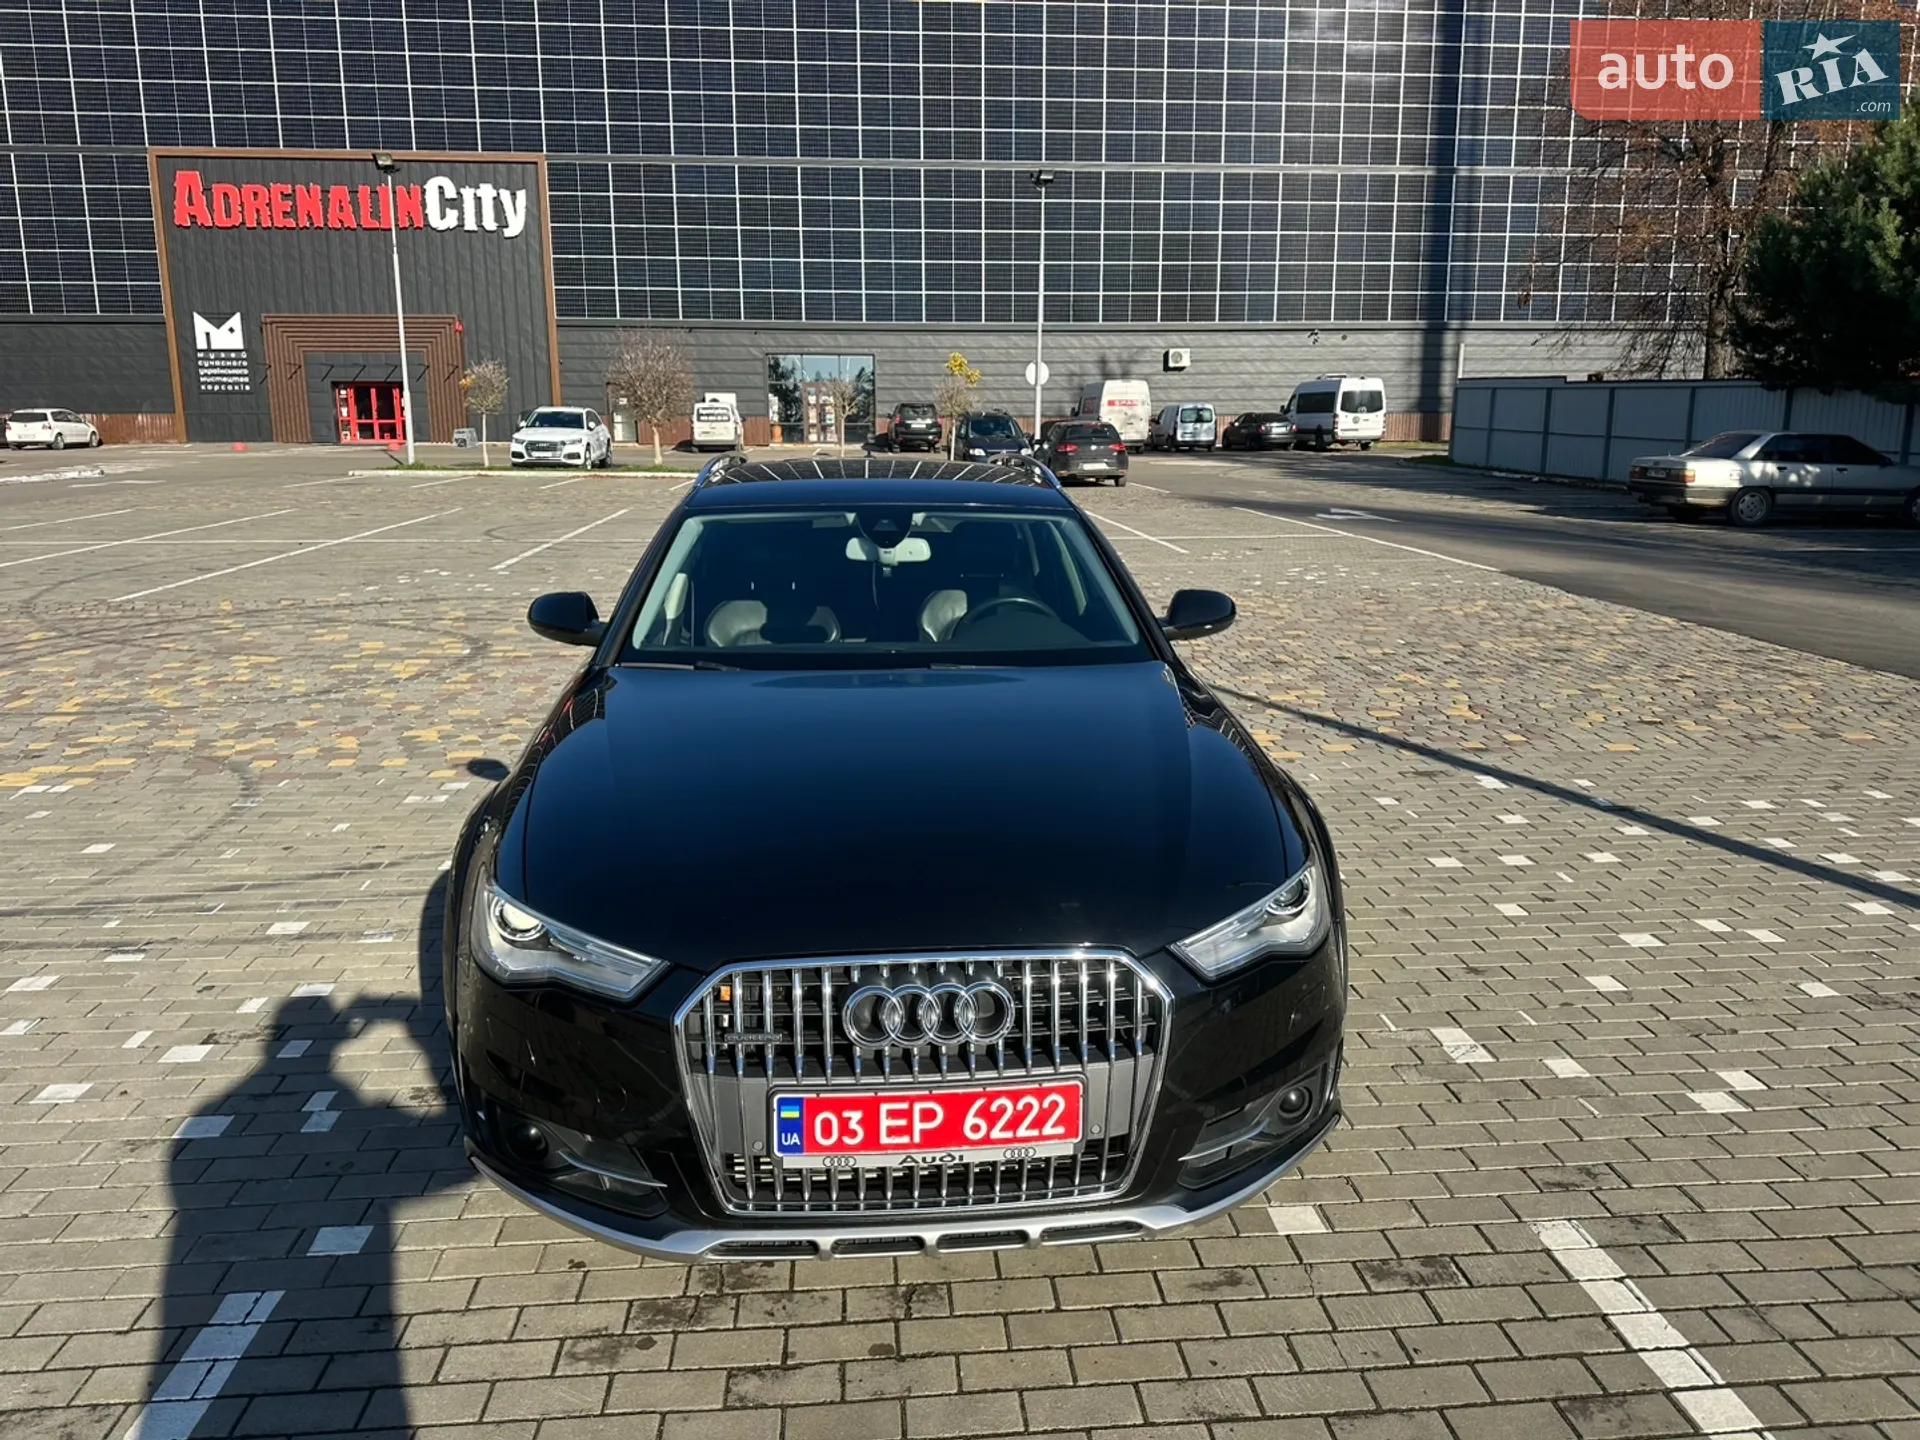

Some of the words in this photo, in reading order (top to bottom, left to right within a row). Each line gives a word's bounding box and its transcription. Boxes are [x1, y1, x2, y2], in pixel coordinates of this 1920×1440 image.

[814, 1110, 865, 1147] 03
[879, 1101, 944, 1145] EP
[963, 1093, 1066, 1140] 6222
[781, 1132, 801, 1146] UA
